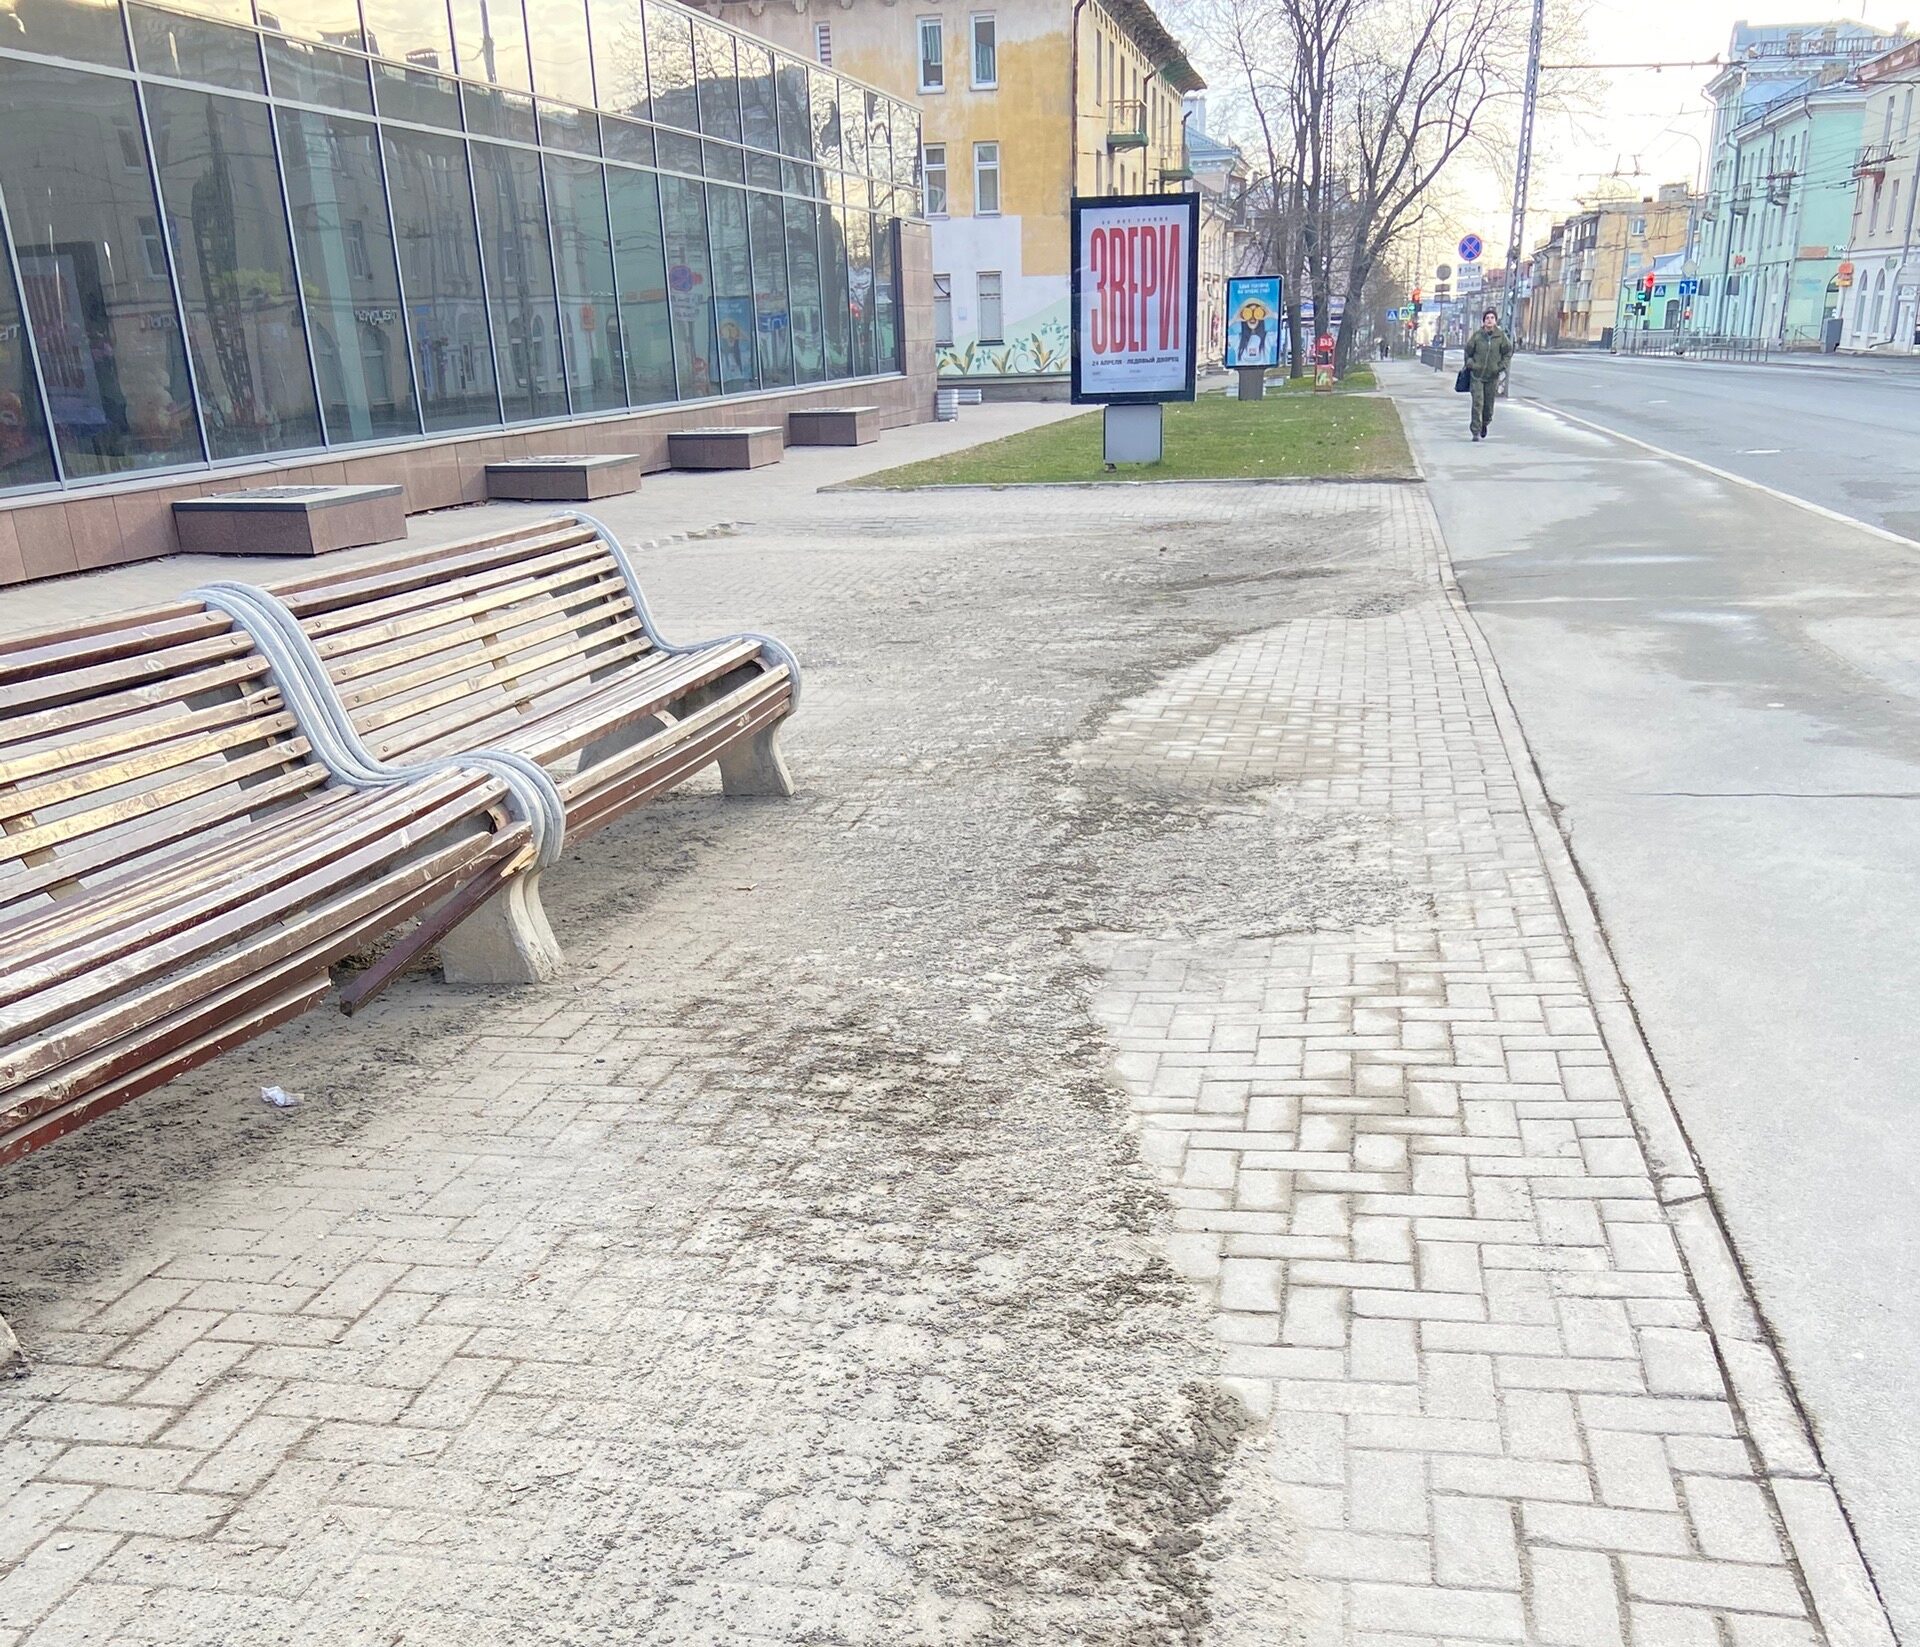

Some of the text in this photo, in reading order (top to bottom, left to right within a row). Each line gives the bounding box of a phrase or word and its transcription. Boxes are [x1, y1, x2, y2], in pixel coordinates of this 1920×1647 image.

[1091, 224, 1179, 355] ЗВЕРИ
[1127, 357, 1155, 365] ЛЕДОВЫЙ
[1156, 356, 1179, 364] ДВОРЕЦ
